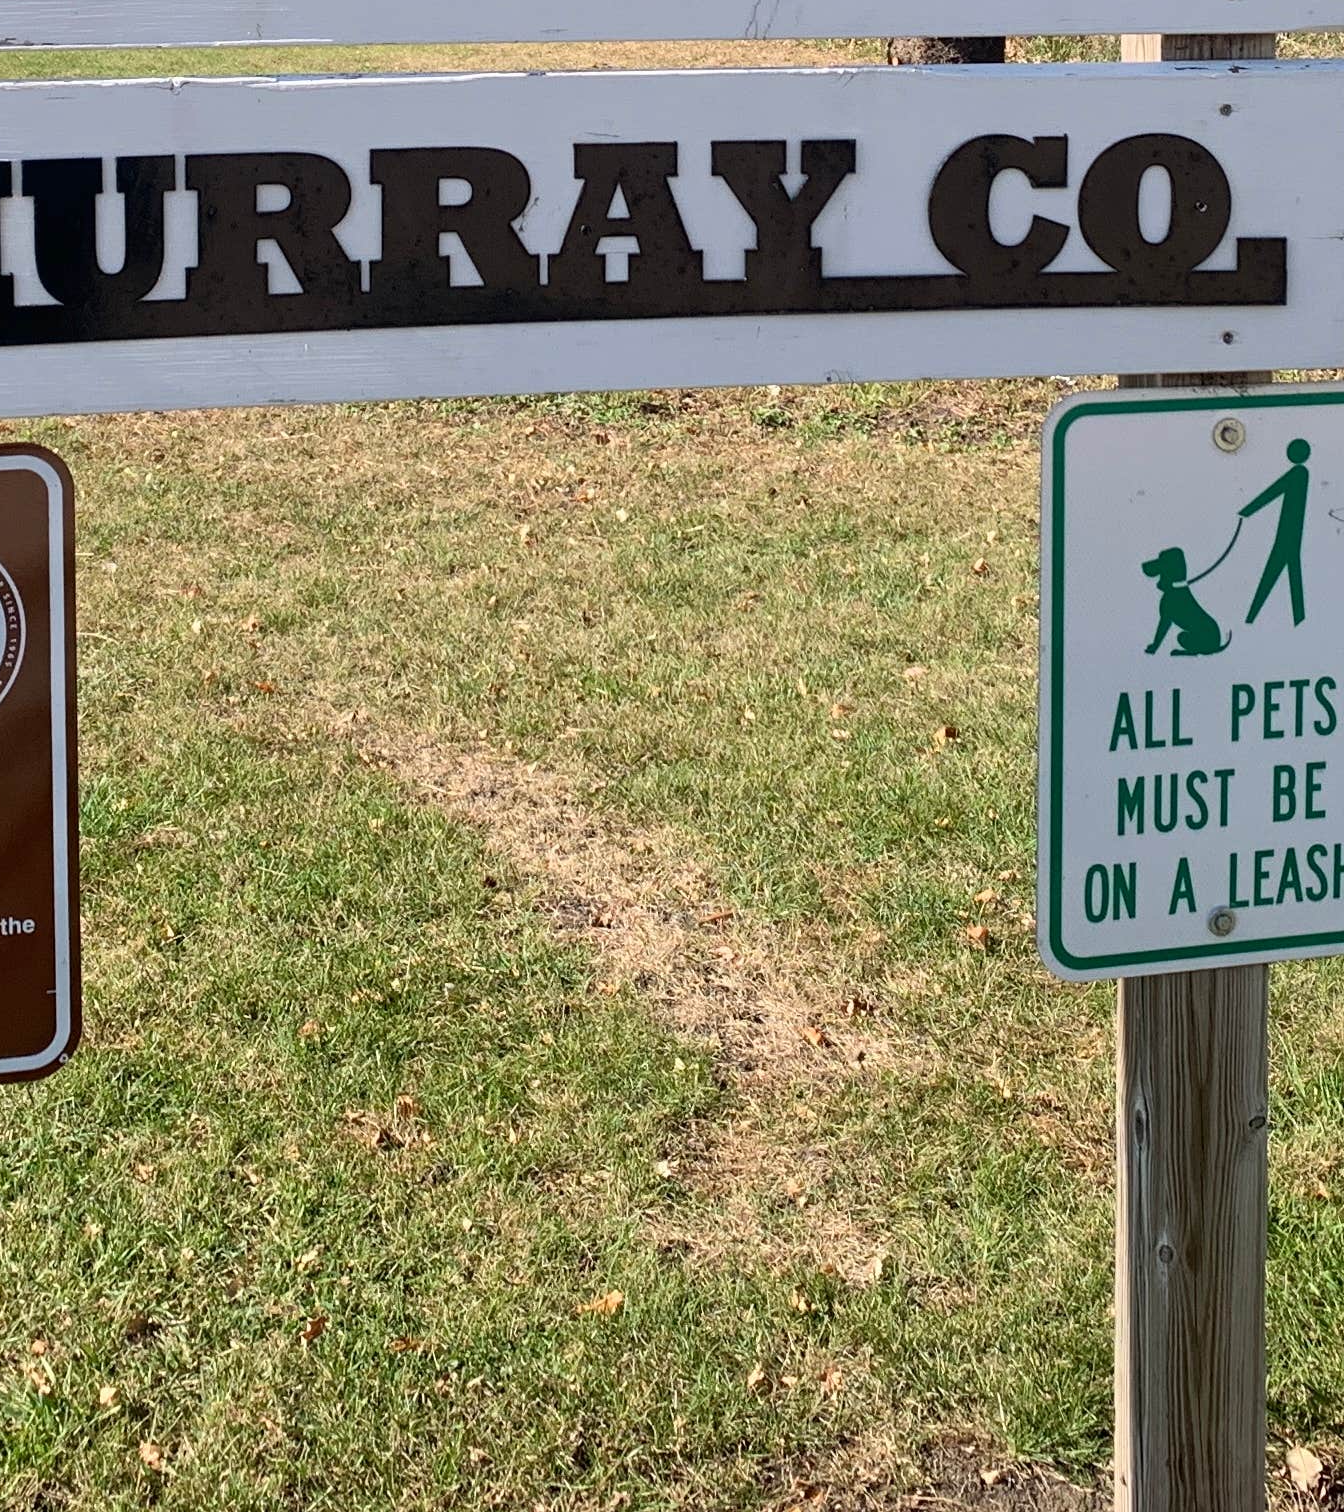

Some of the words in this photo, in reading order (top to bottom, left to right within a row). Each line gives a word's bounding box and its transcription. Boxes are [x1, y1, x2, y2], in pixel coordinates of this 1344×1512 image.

[2, 593, 18, 630] SINCE
[1109, 688, 1193, 752] ALL
[1231, 676, 1338, 742] PETS
[1117, 769, 1235, 836] MUST
[1272, 761, 1327, 823] BE
[1084, 861, 1137, 923] ON
[1168, 857, 1197, 916] A
[0, 917, 36, 934] the
